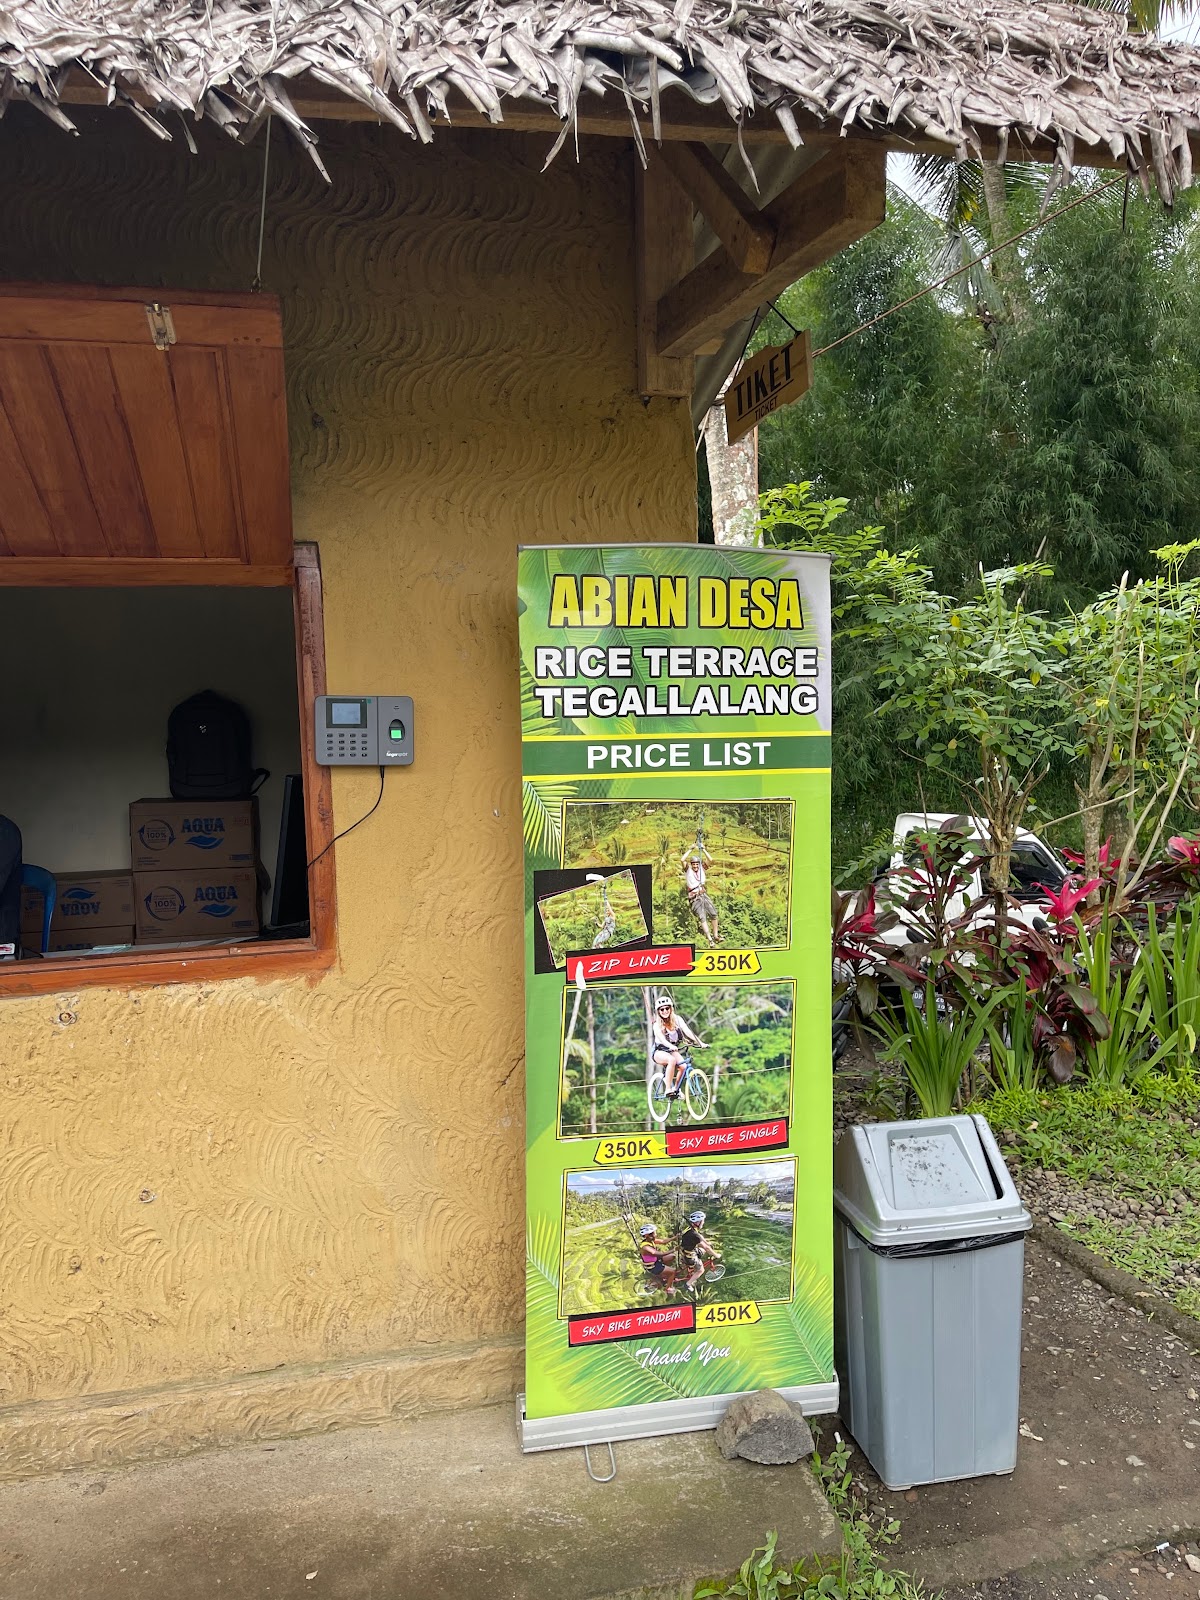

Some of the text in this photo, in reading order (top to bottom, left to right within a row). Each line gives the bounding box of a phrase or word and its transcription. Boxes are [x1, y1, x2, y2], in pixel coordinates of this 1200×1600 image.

[734, 342, 793, 416] TIKET
[755, 395, 778, 421] TICKET
[548, 573, 804, 630] ABIAN DESA
[535, 646, 818, 678] RICE TERRACE
[535, 684, 819, 719] TEGALLALANG
[587, 742, 771, 769] PRICE LIST
[181, 817, 226, 835] AQUA
[154, 900, 176, 908] 100%
[193, 885, 238, 903] AQUA
[60, 901, 101, 916] AQUA
[588, 953, 670, 973] ZIP LINE
[705, 953, 752, 971] 350K
[604, 1139, 652, 1159] 350K
[679, 1125, 779, 1150] SKY BIKE SINGLE
[582, 1310, 681, 1337] SKY BIKE TANDEM
[705, 1304, 752, 1323] 450K
[635, 1340, 731, 1369] Thank You
